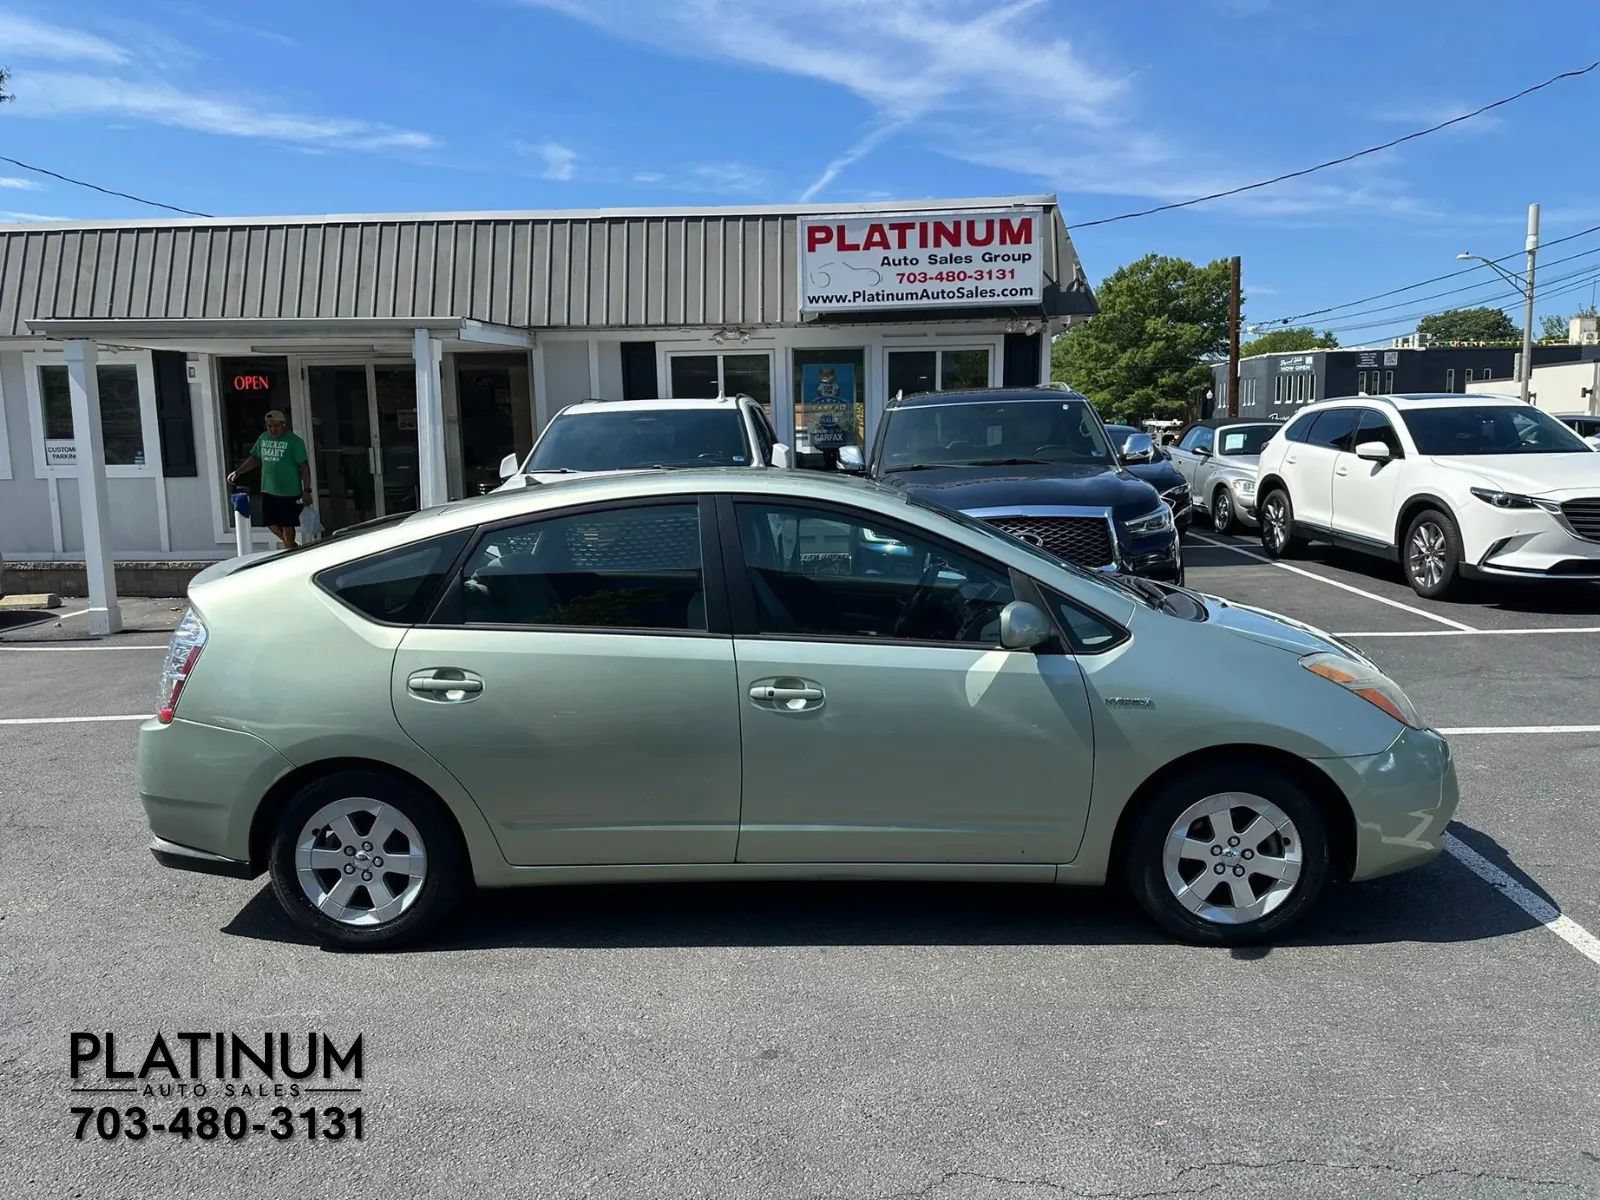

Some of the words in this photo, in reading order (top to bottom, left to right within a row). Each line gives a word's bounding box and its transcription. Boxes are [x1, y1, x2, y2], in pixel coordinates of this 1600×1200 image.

[807, 218, 1033, 252] PLATINUM
[880, 255, 919, 267] Auto
[927, 253, 973, 266] Sales
[981, 251, 1032, 266] Group
[896, 269, 1016, 284] 703-480-3131
[807, 286, 1034, 305] www.PlatinumAutoSales.com
[234, 375, 269, 391] OPEN
[814, 433, 843, 441] CARFAX
